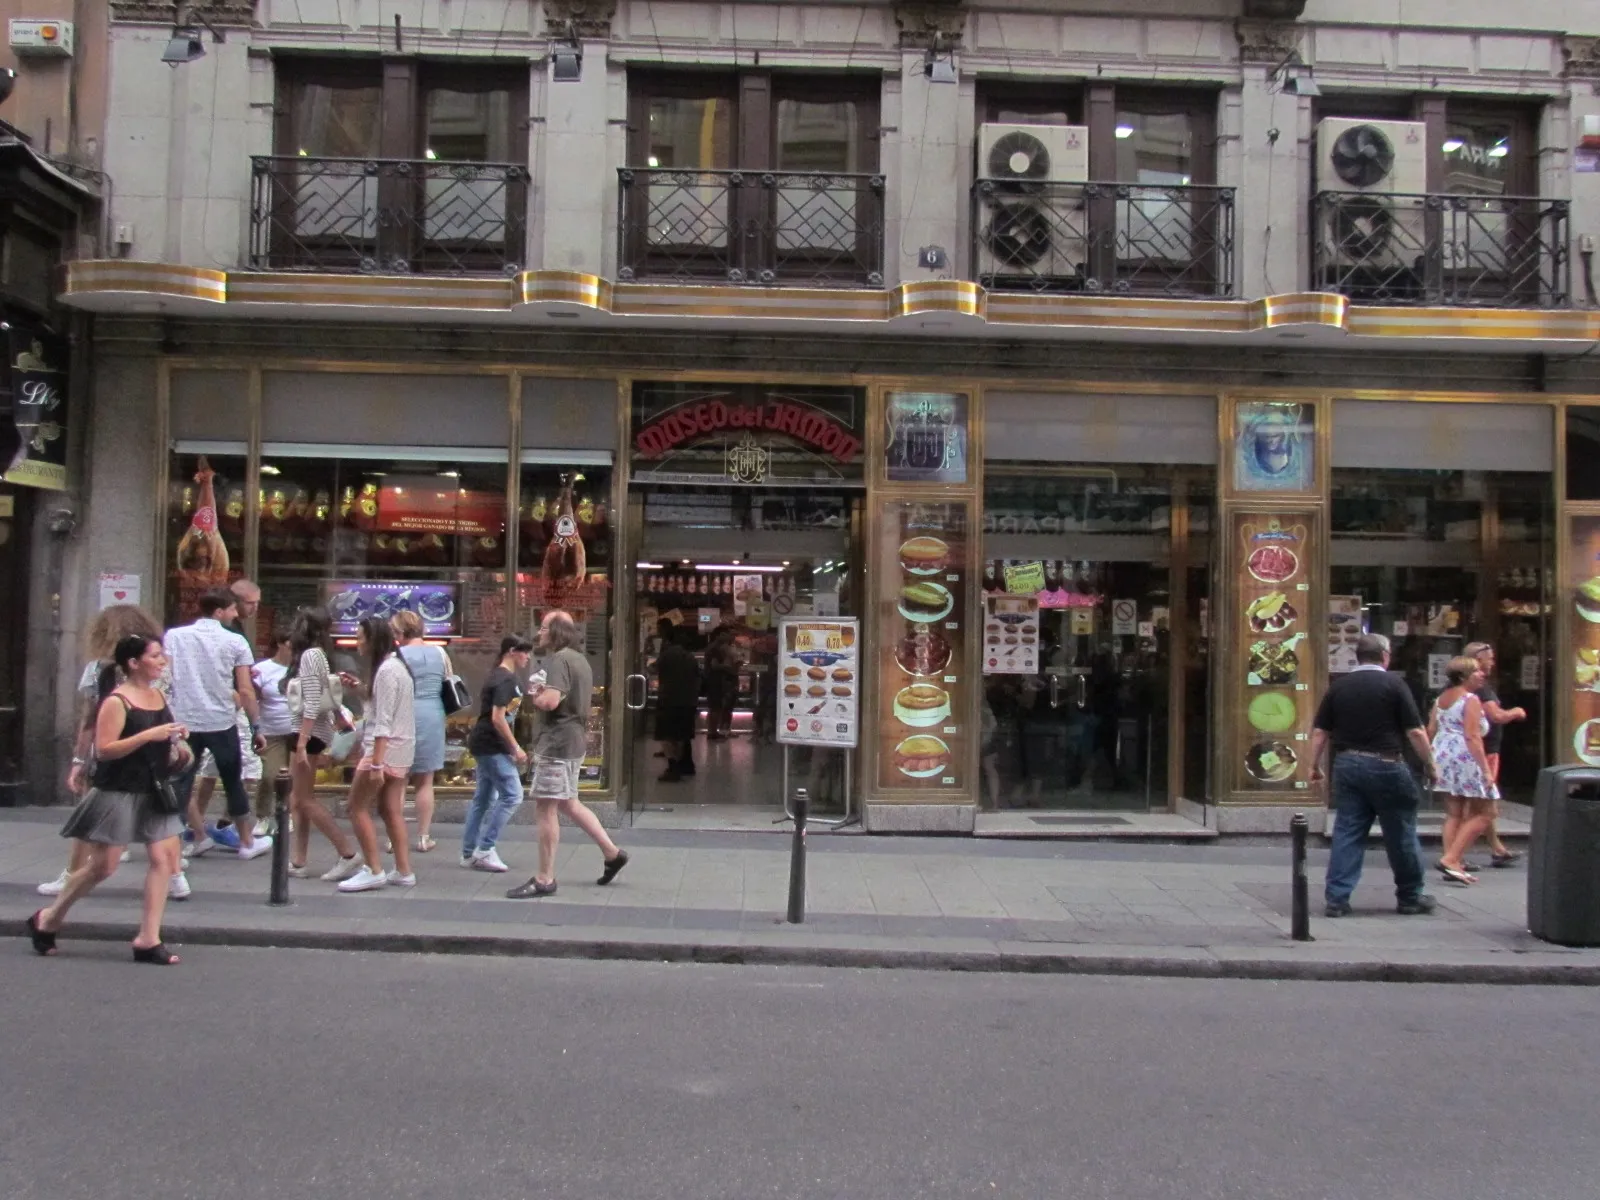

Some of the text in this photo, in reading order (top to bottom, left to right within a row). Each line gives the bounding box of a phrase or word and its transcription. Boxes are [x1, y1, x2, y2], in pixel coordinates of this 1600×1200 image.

[926, 250, 937, 264] 6
[637, 400, 728, 457] MUSEO
[729, 405, 763, 428] del
[449, 519, 479, 527] ESOGIDO
